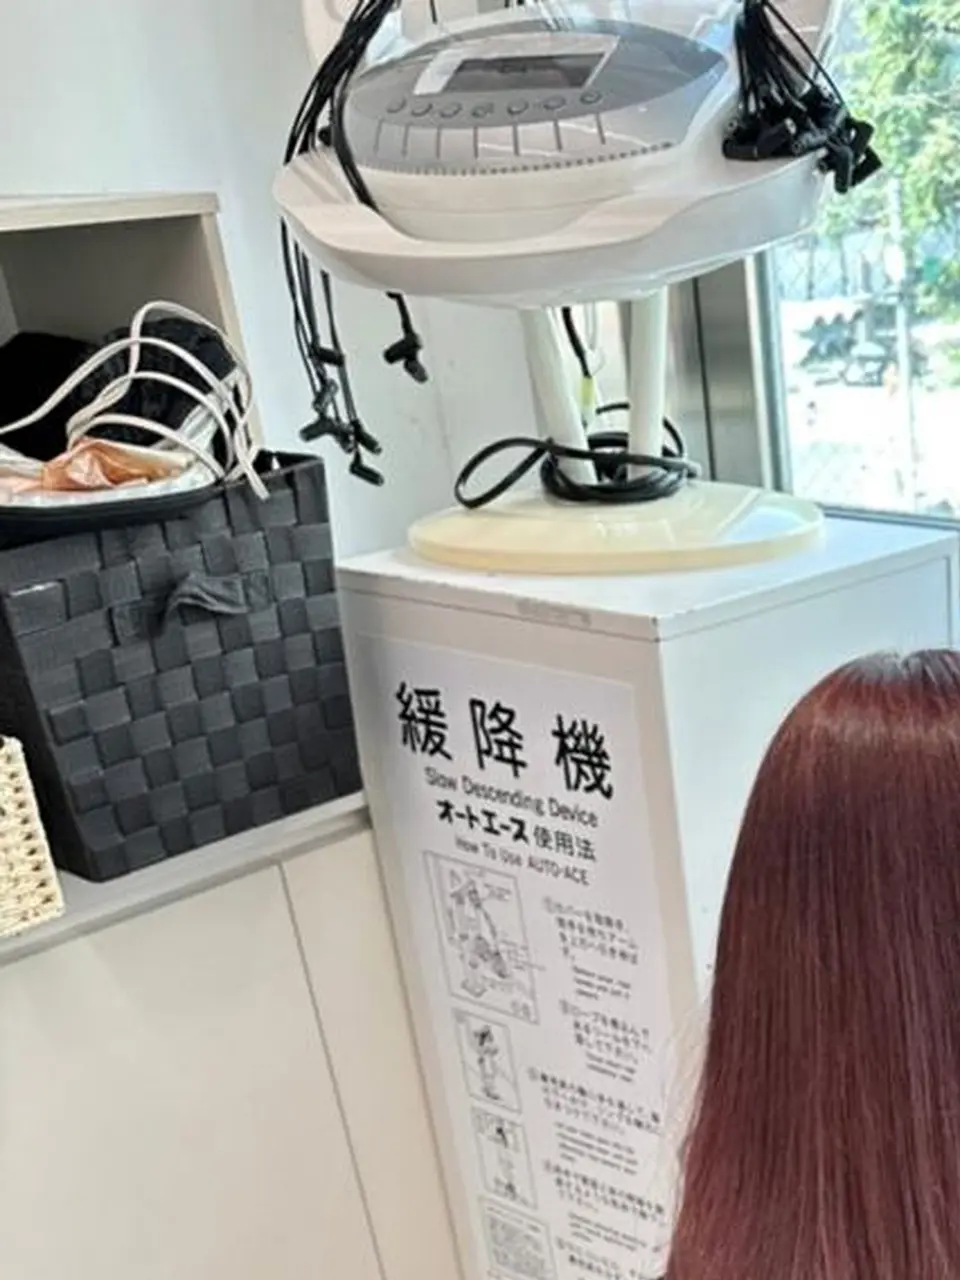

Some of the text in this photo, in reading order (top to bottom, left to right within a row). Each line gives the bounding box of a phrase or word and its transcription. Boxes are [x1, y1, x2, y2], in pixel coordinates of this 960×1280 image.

[395, 681, 613, 800] 緩降機
[424, 766, 598, 828] Slow Descending Device
[437, 800, 596, 862] オートエース 使用法
[527, 855, 589, 886] AUTO-ACE
